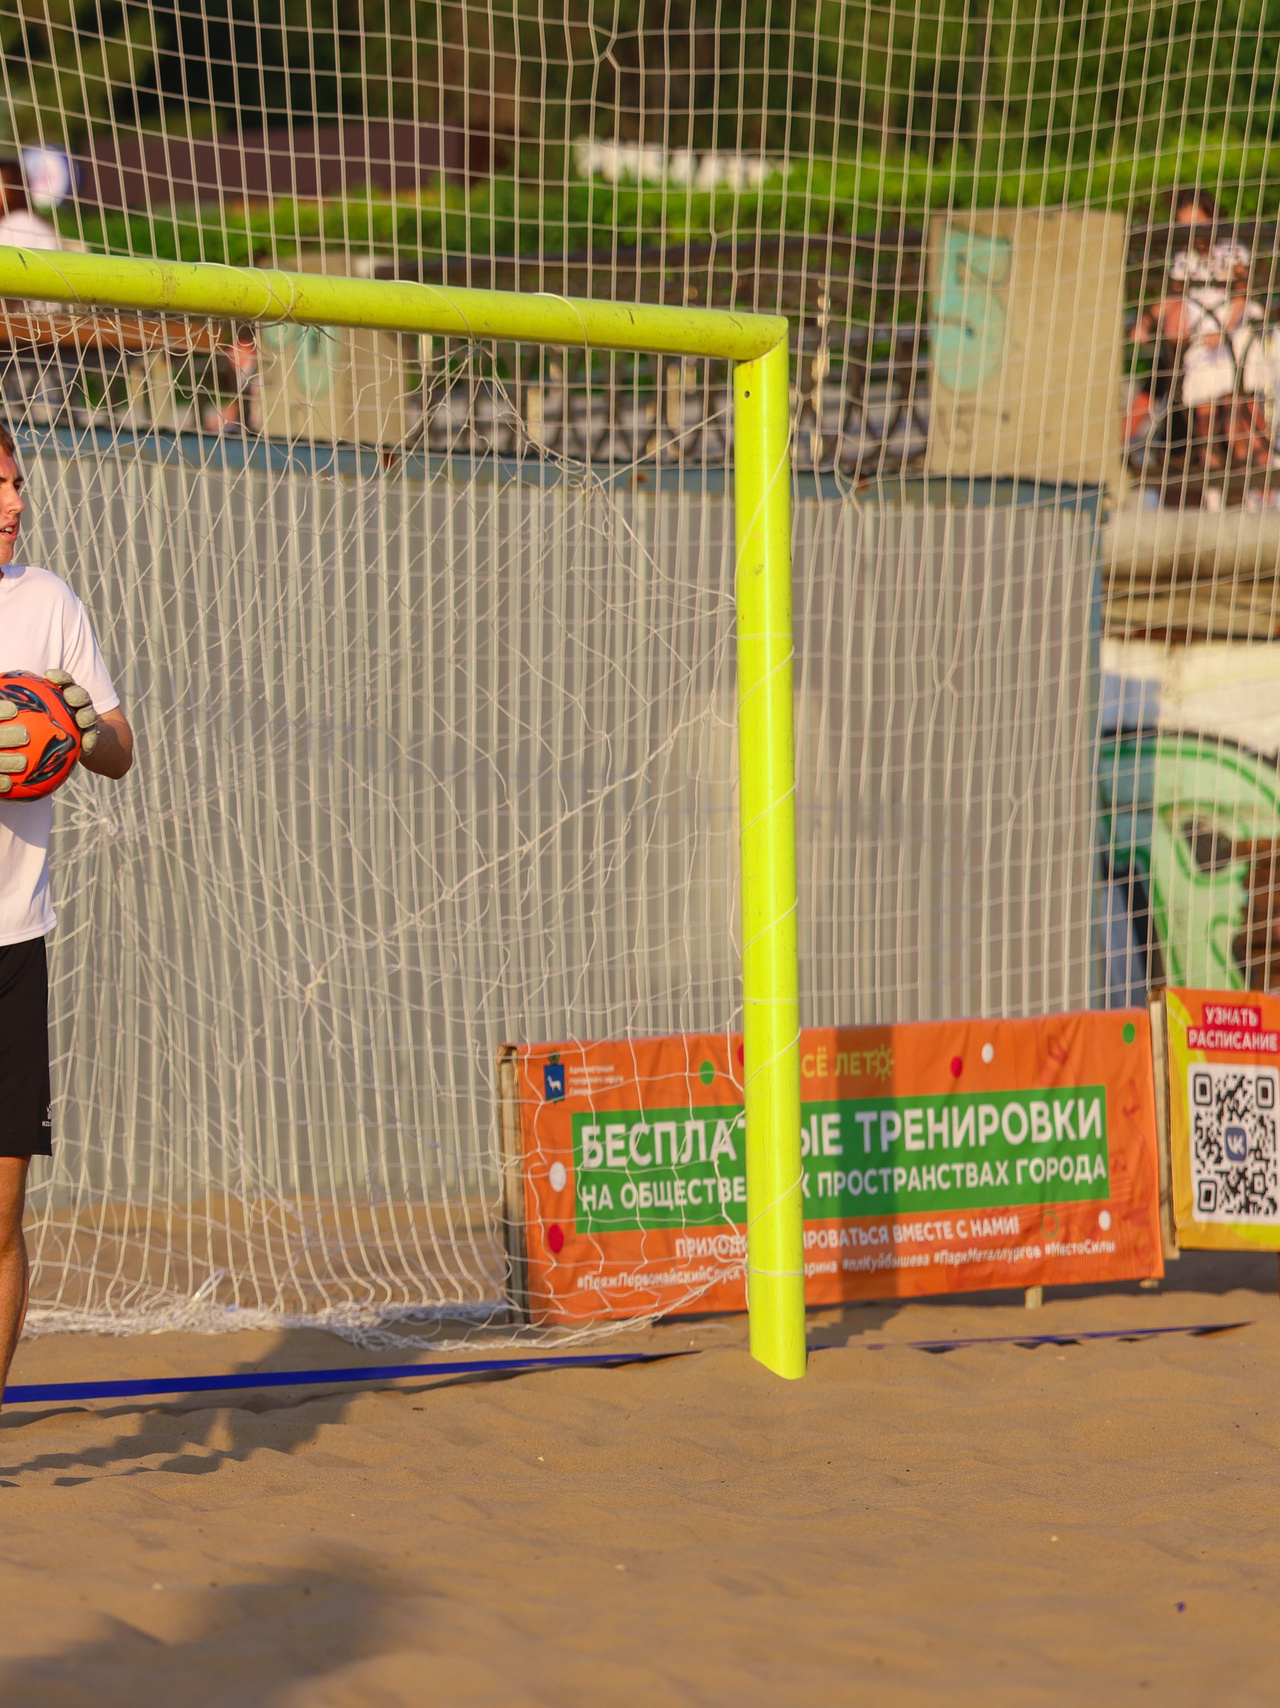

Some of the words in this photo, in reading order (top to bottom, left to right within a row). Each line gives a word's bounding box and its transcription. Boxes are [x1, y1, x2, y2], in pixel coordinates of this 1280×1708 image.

[1205, 1005, 1259, 1027] УЗНАТЬ
[1187, 1028, 1279, 1053] РАСПИСАНИЕ
[801, 1046, 829, 1079] СЁ
[581, 1112, 843, 1169] БЕСПЛАЫЕ
[855, 1097, 1103, 1154] ТРЕНИРОВКИ
[582, 1184, 614, 1211] НА
[817, 1160, 1010, 1198] ПРОСТРАНСТВАХ
[1015, 1153, 1107, 1185] ГОРОДА
[892, 1220, 952, 1243] ВМЕСТЕ
[956, 1220, 968, 1240] С
[970, 1215, 1020, 1238] НАМИ!
